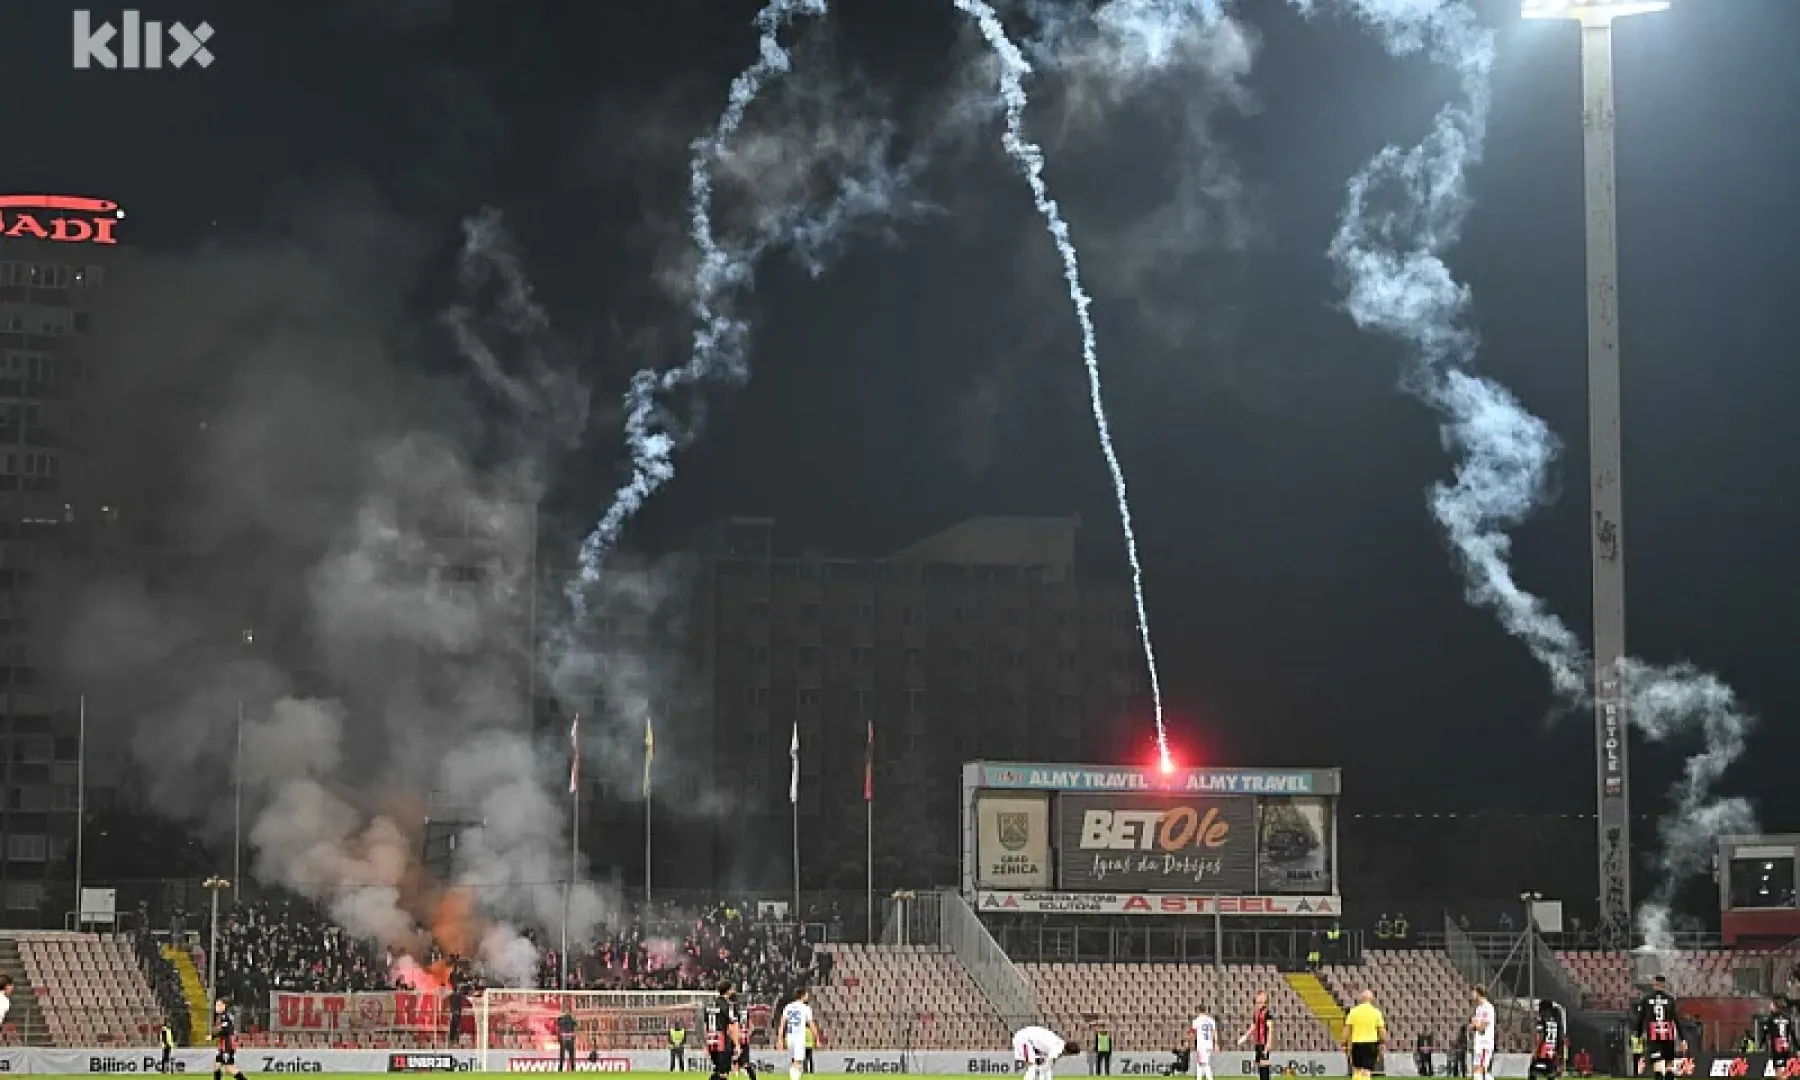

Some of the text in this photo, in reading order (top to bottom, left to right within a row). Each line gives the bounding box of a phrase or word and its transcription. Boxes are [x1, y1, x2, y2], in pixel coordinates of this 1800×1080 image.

[0, 209, 117, 244] ADI
[1030, 770, 1080, 787] ALMY
[1084, 773, 1148, 789] TRAVEL
[1186, 773, 1307, 791] ALMY TRAVEL
[992, 864, 1038, 875] ZENICA
[90, 1057, 185, 1074] Bilino Poje
[263, 1057, 322, 1073] Zenica
